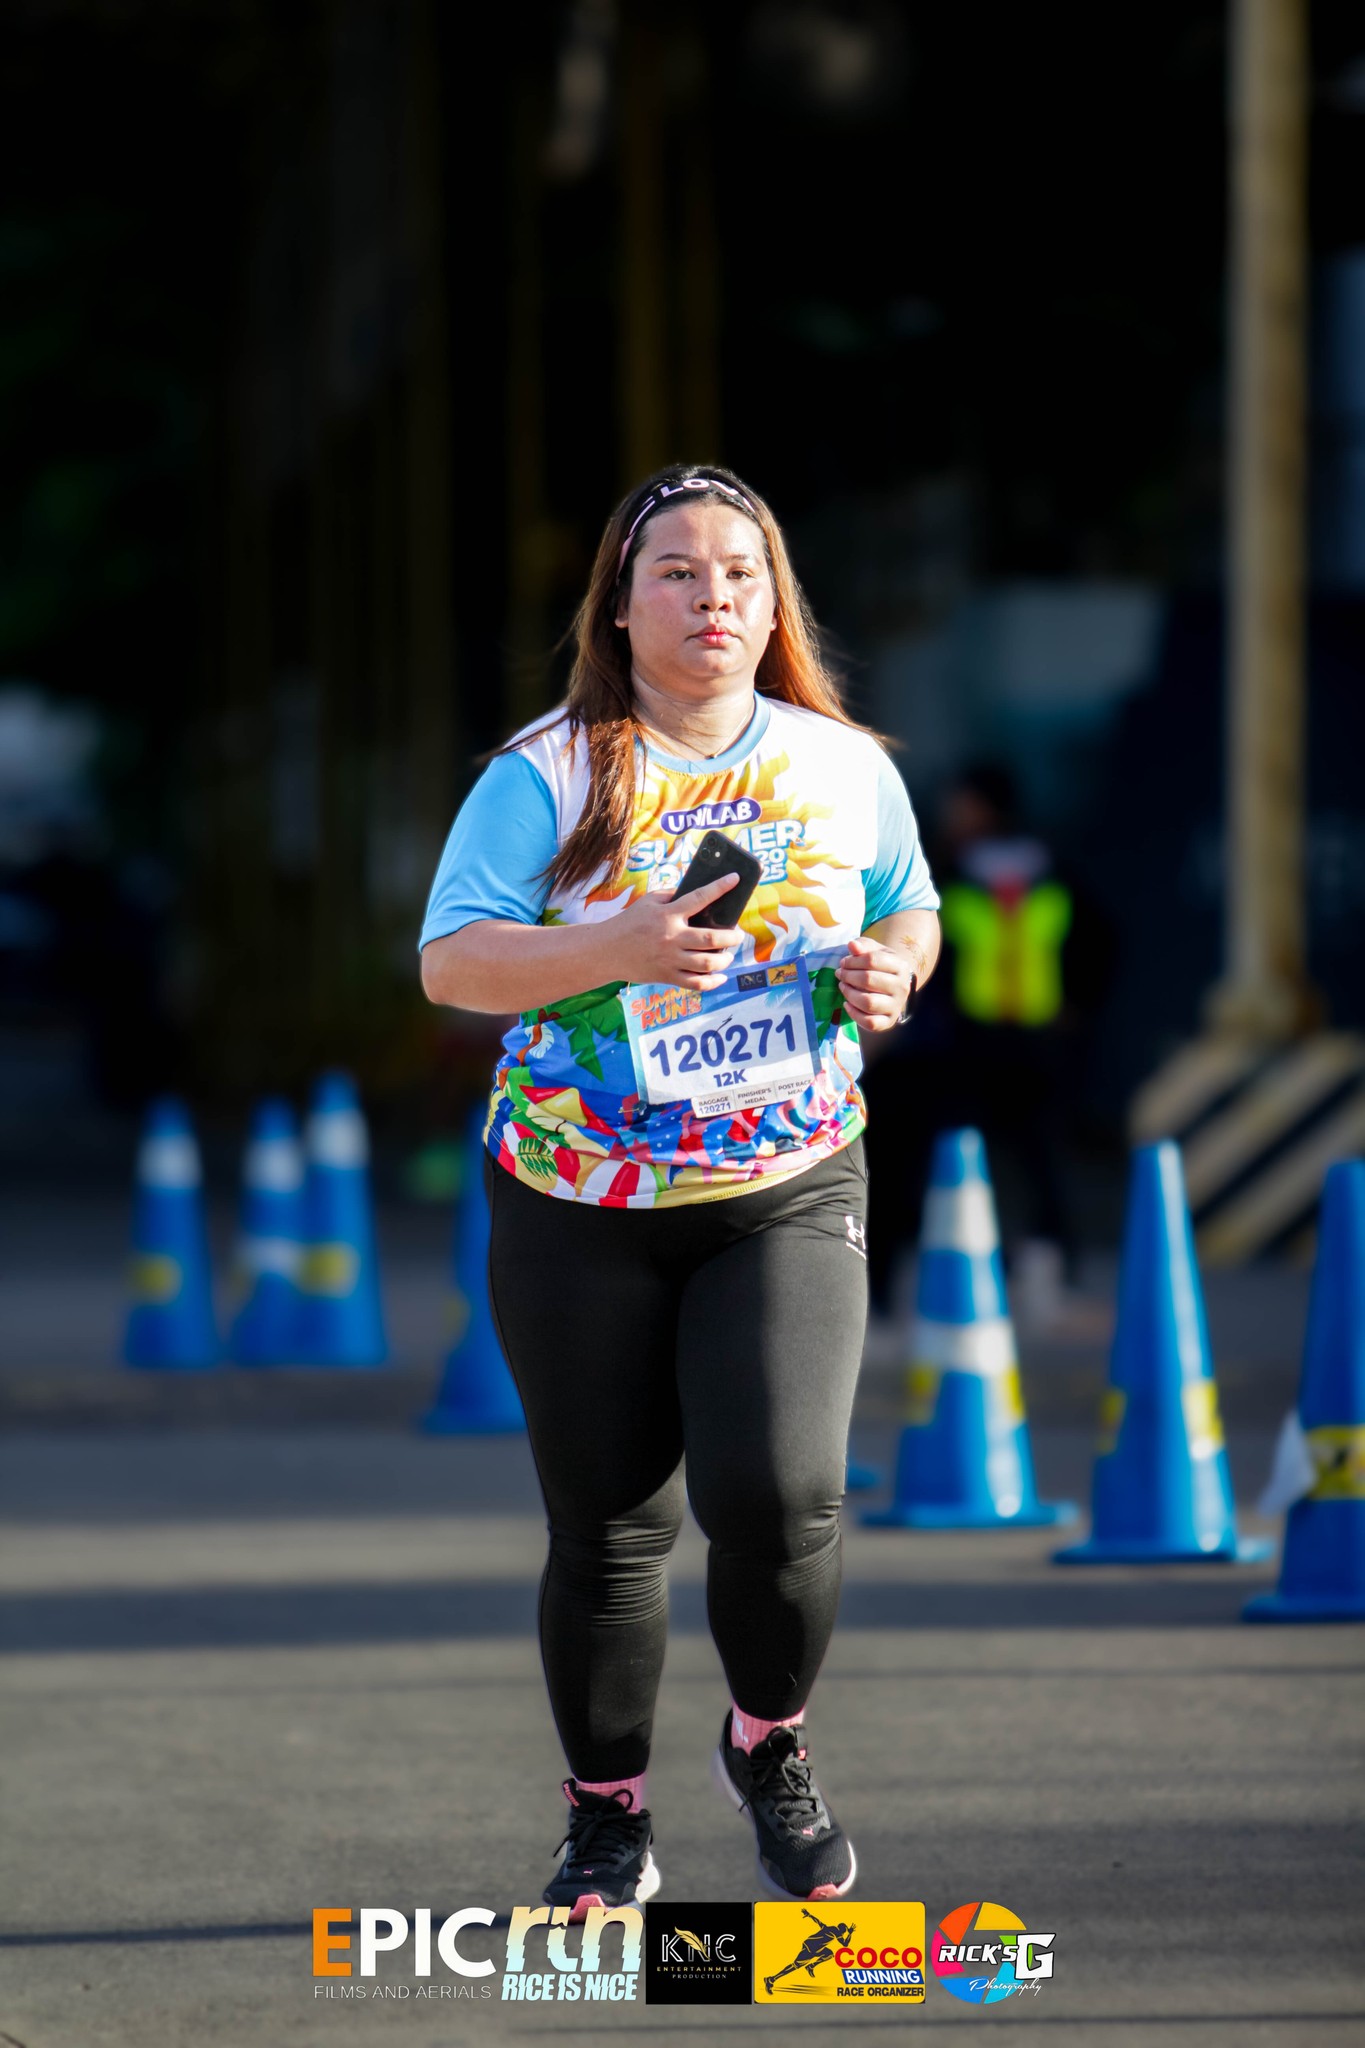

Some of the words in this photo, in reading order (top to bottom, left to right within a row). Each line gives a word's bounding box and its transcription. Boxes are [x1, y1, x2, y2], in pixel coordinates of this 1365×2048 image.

[667, 801, 753, 832] UNILAB
[641, 1000, 687, 1030] RUN
[649, 1014, 796, 1076] 120271
[713, 1069, 748, 1088] 12K
[737, 1088, 772, 1099] FINISHER'S
[778, 1083, 794, 1091] POST
[699, 1102, 731, 1115] 120271
[744, 1096, 767, 1105] MEDAL
